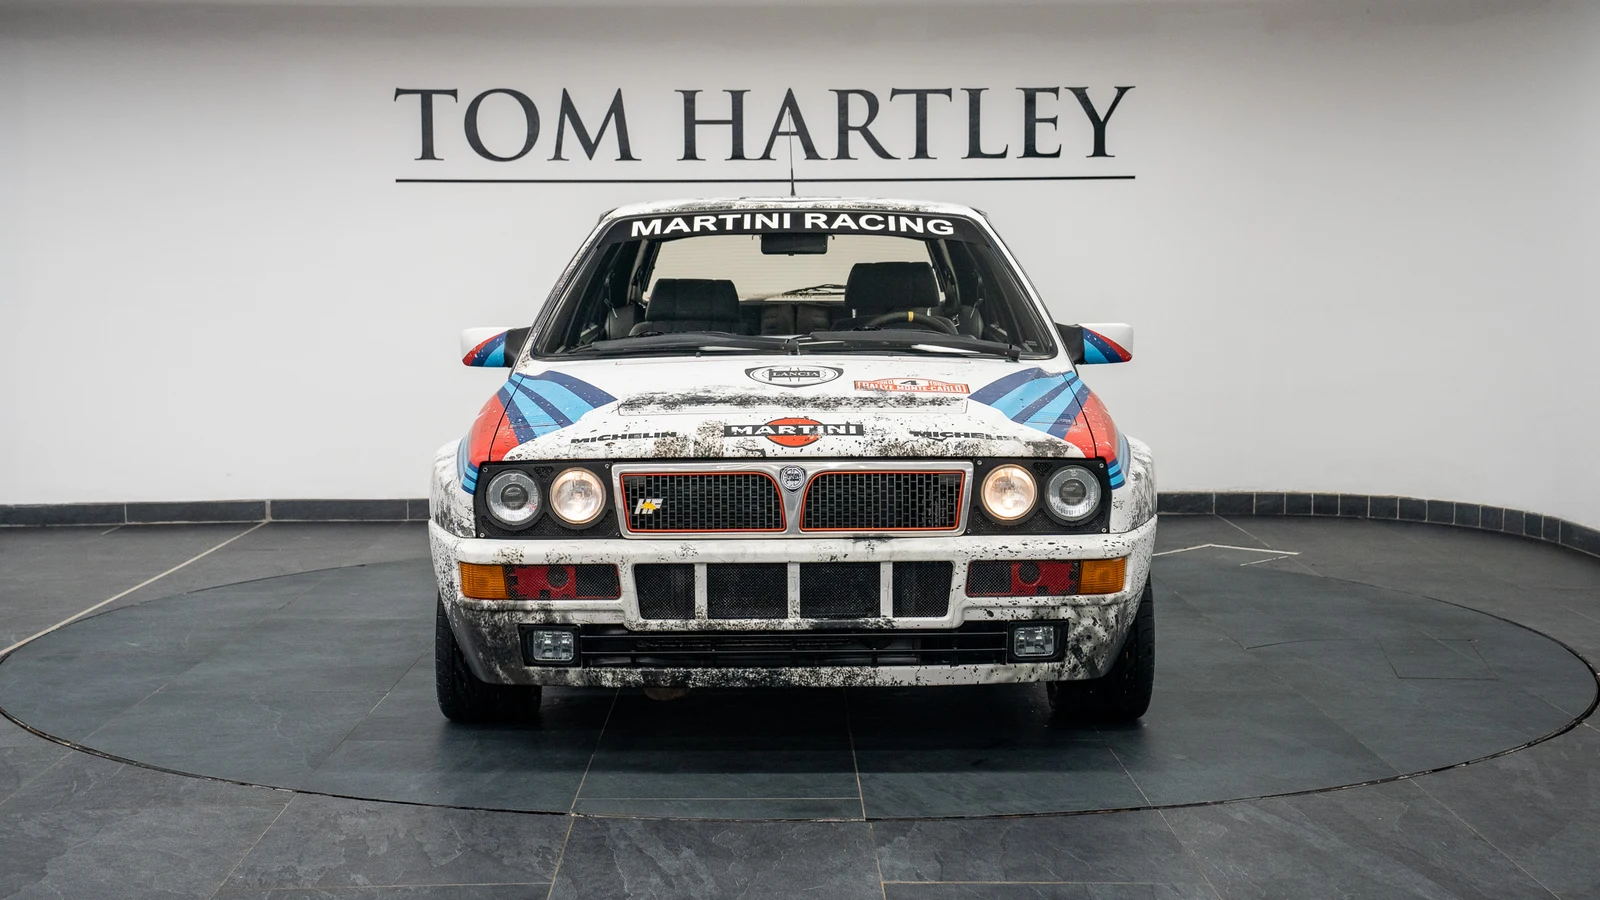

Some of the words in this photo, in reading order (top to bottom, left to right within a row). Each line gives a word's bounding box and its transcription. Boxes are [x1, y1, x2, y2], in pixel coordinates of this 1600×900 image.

[394, 87, 642, 162] TOM
[674, 86, 1136, 161] HARTLEY
[631, 213, 791, 237] MARTINI
[804, 213, 955, 236] RACING
[570, 432, 677, 444] MICHELIN
[730, 424, 857, 435] MARTINI
